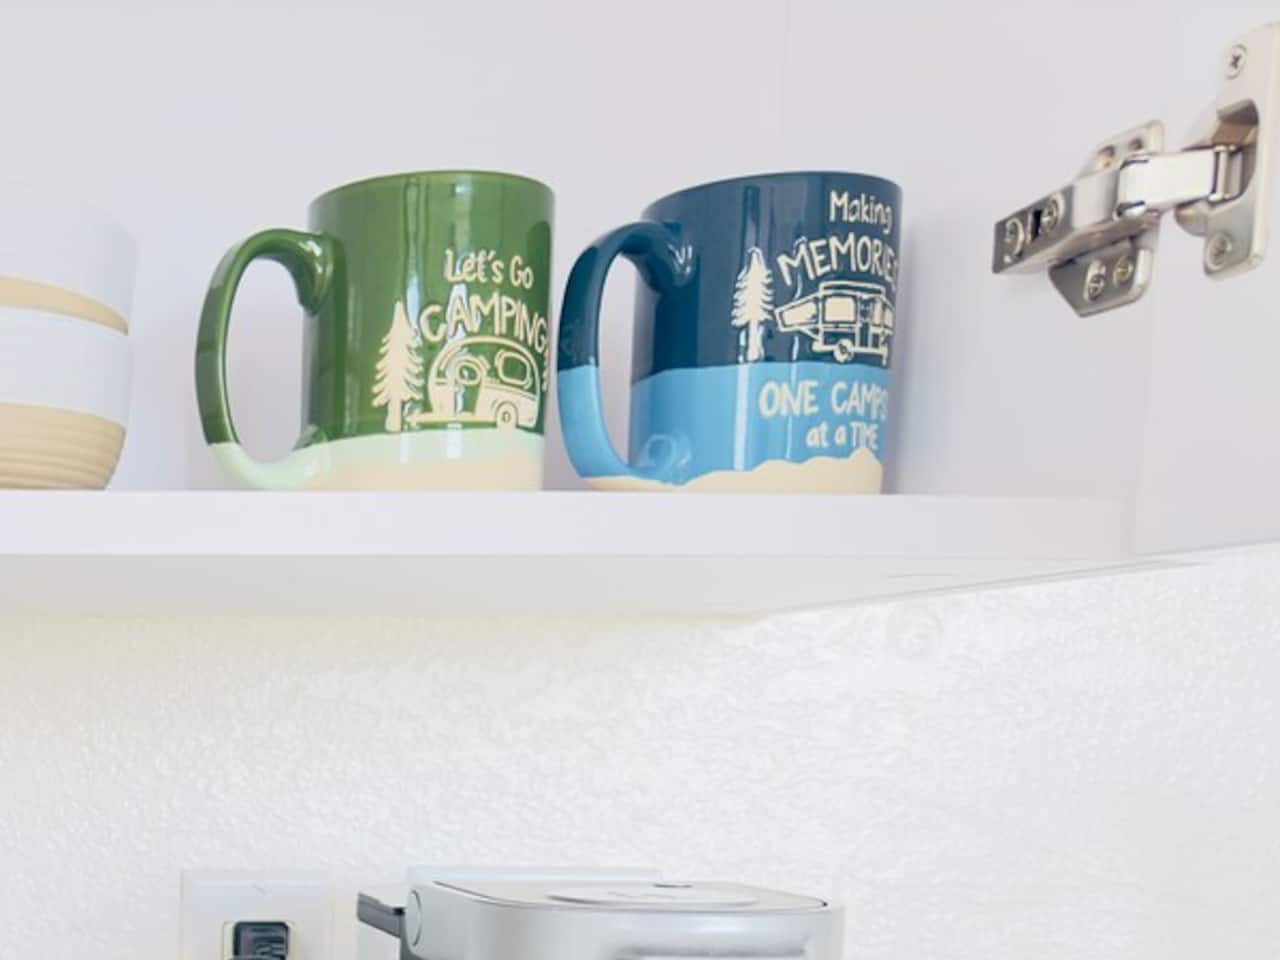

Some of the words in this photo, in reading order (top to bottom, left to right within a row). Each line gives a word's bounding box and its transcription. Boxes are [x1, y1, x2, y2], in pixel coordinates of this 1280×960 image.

[829, 190, 892, 235] Making
[443, 248, 504, 284] Let's
[509, 255, 535, 290] Go
[419, 290, 548, 354] CAMPING
[759, 379, 819, 418] ONE
[805, 420, 829, 449] at
[834, 426, 847, 447] a
